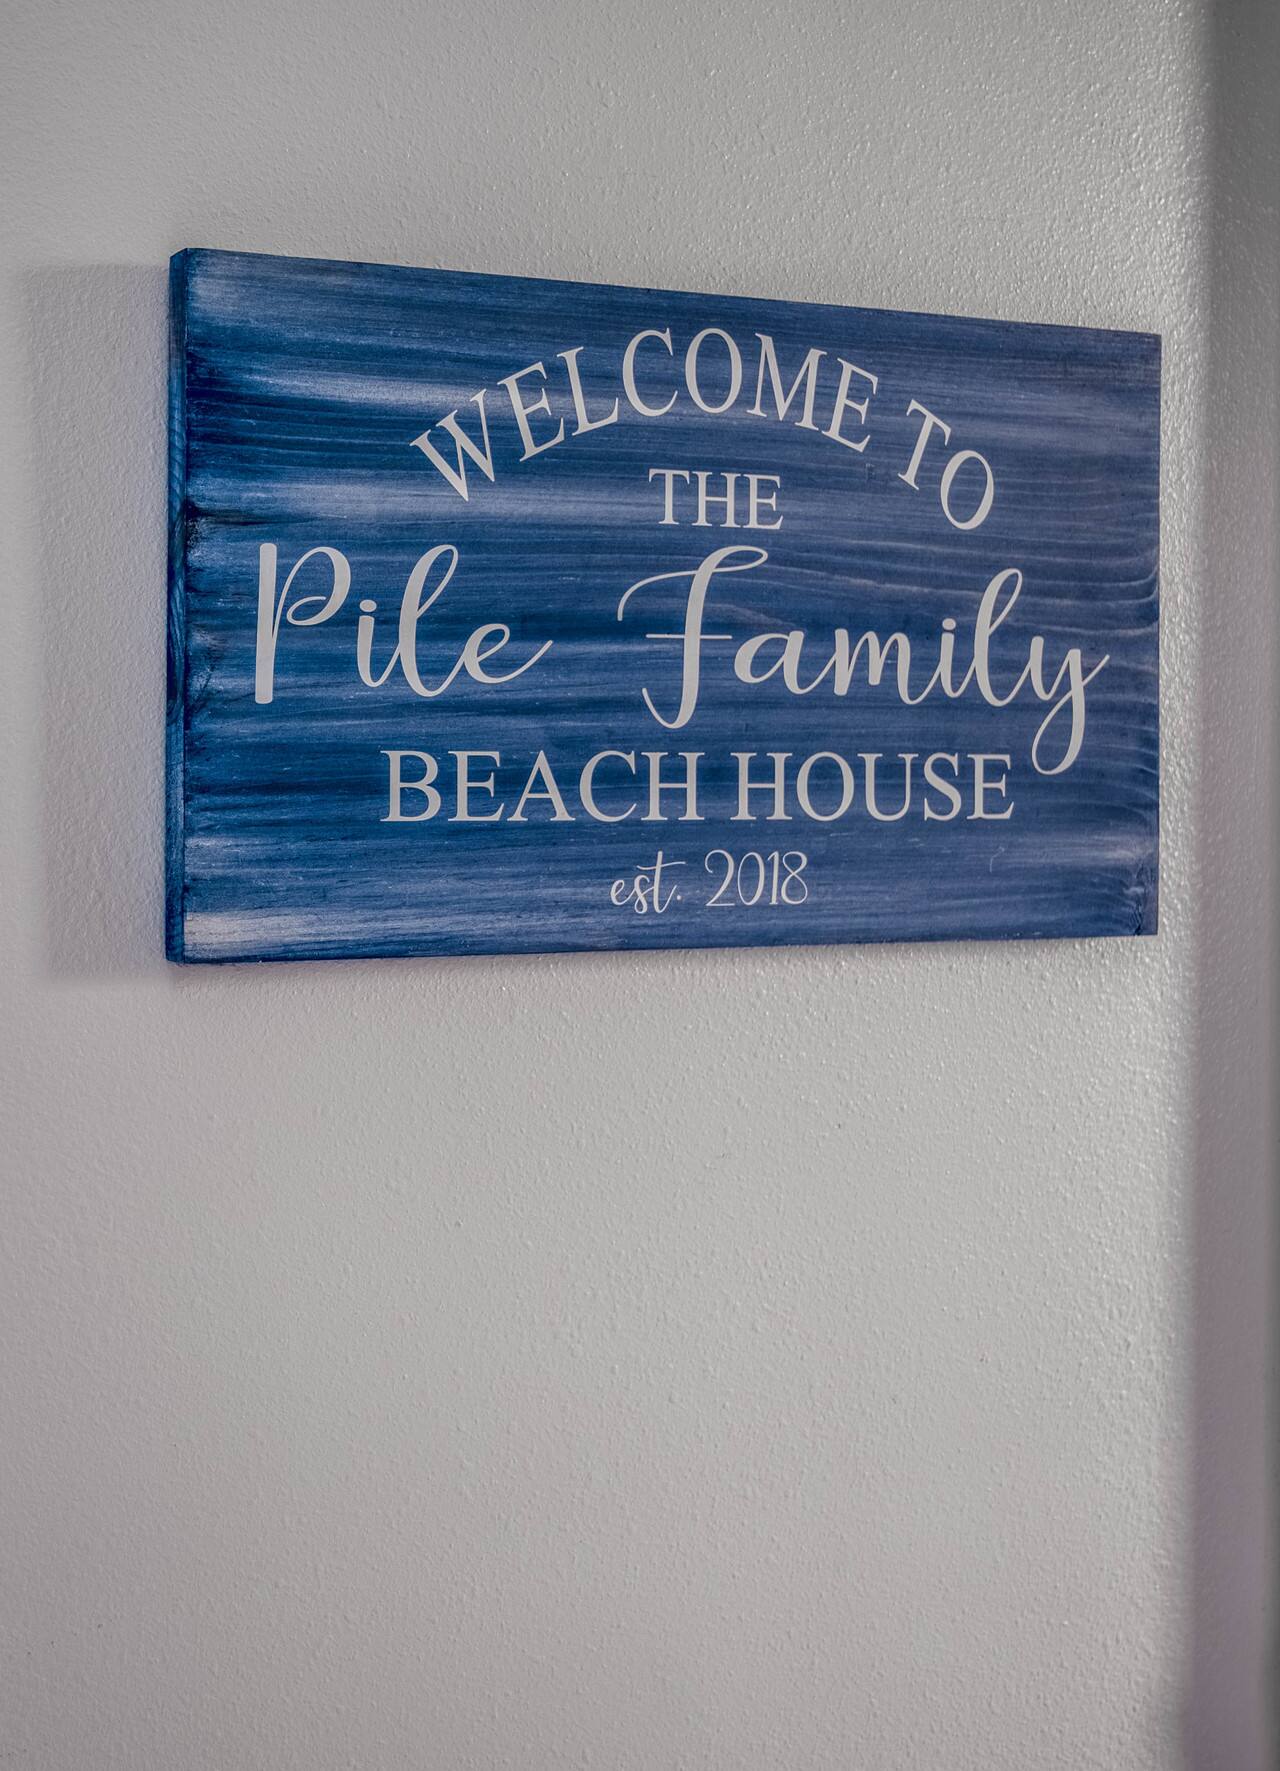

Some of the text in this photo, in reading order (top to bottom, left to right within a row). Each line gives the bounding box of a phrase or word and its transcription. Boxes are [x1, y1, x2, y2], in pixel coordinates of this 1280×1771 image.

[410, 327, 995, 531] WELCOME TO
[648, 469, 783, 530] THE
[255, 543, 1110, 775] Pile Family
[380, 750, 1015, 822] BEACH HOUSE
[610, 850, 808, 914] est. 2018
